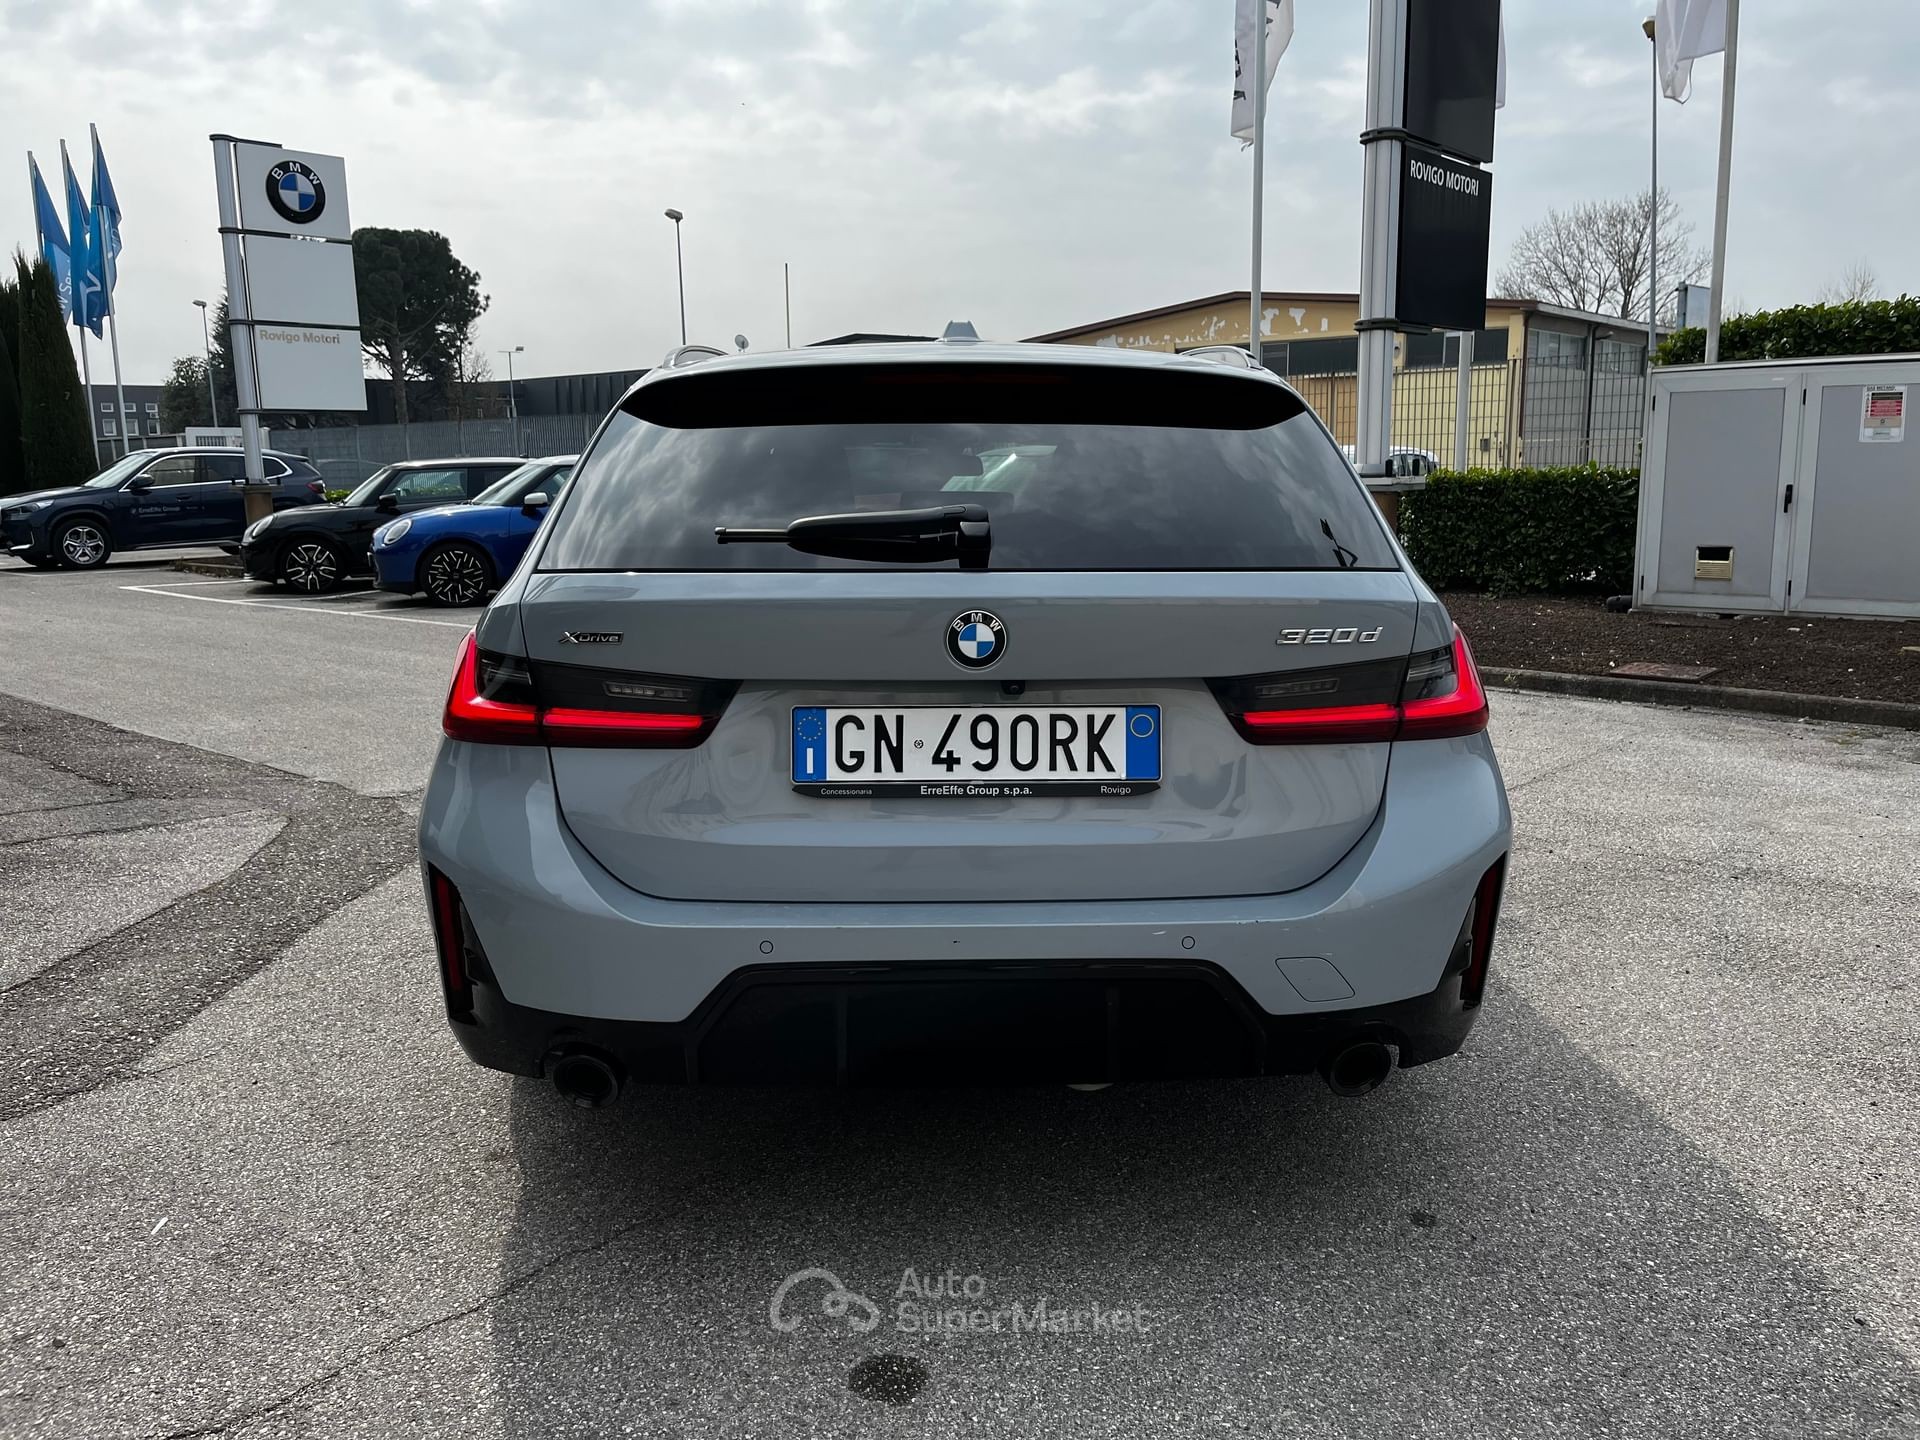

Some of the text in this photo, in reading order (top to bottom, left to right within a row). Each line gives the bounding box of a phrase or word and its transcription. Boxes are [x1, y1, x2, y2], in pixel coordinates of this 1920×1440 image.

[1410, 160, 1479, 196] ROVIGO MOTORI
[260, 329, 341, 345] Rovigo Motori
[1276, 626, 1384, 645] 320d
[820, 787, 873, 796] Concessionaria
[920, 785, 1033, 797] ErreEffe Group s.p.a.
[1100, 785, 1132, 796] Rovigo
